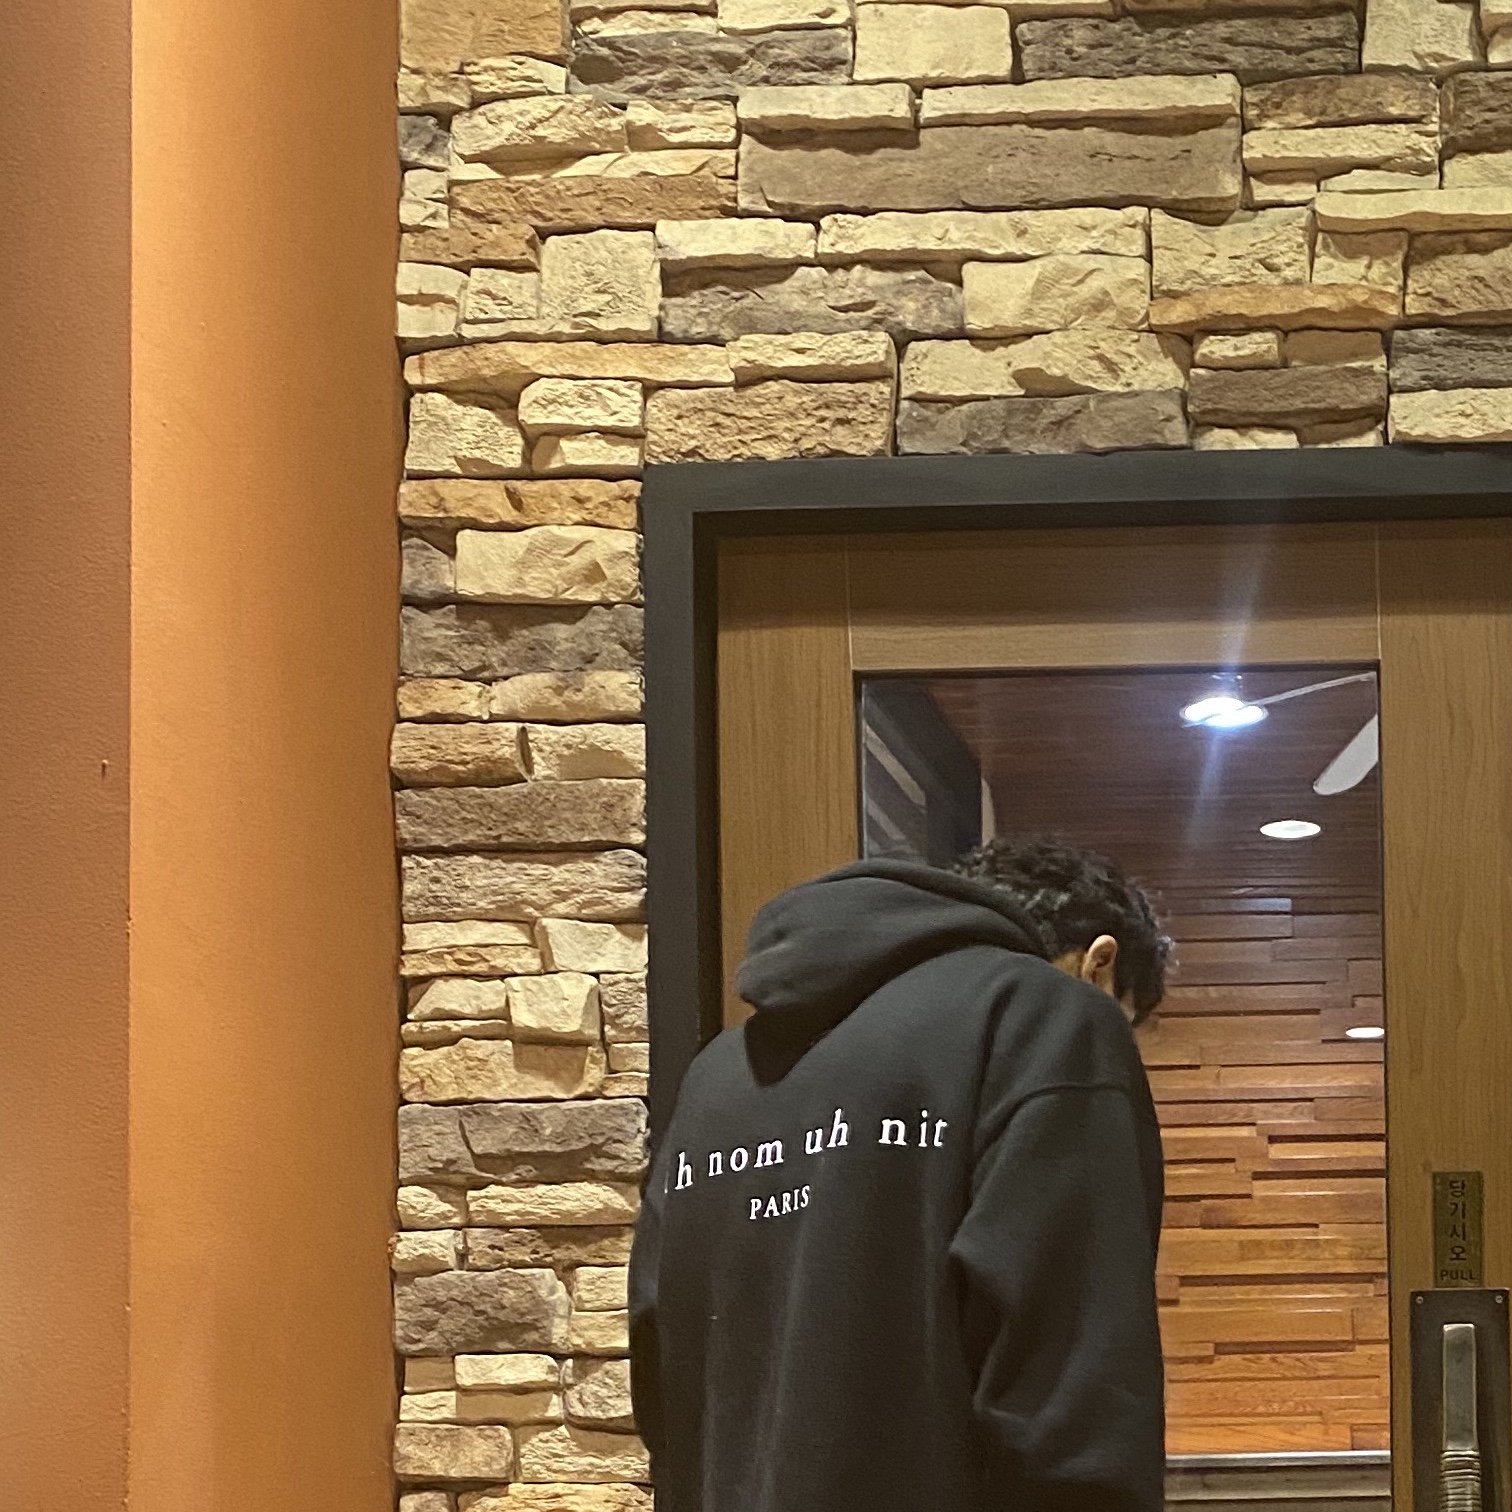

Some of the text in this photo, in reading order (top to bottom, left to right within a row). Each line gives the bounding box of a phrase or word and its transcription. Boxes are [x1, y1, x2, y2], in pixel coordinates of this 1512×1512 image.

[709, 1140, 784, 1177] nom
[804, 1108, 849, 1155] uh
[878, 1109, 949, 1147] nit
[749, 1185, 810, 1220] PARIS
[1449, 1179, 1467, 1262] 당기시오
[1440, 1269, 1477, 1281] PULL
